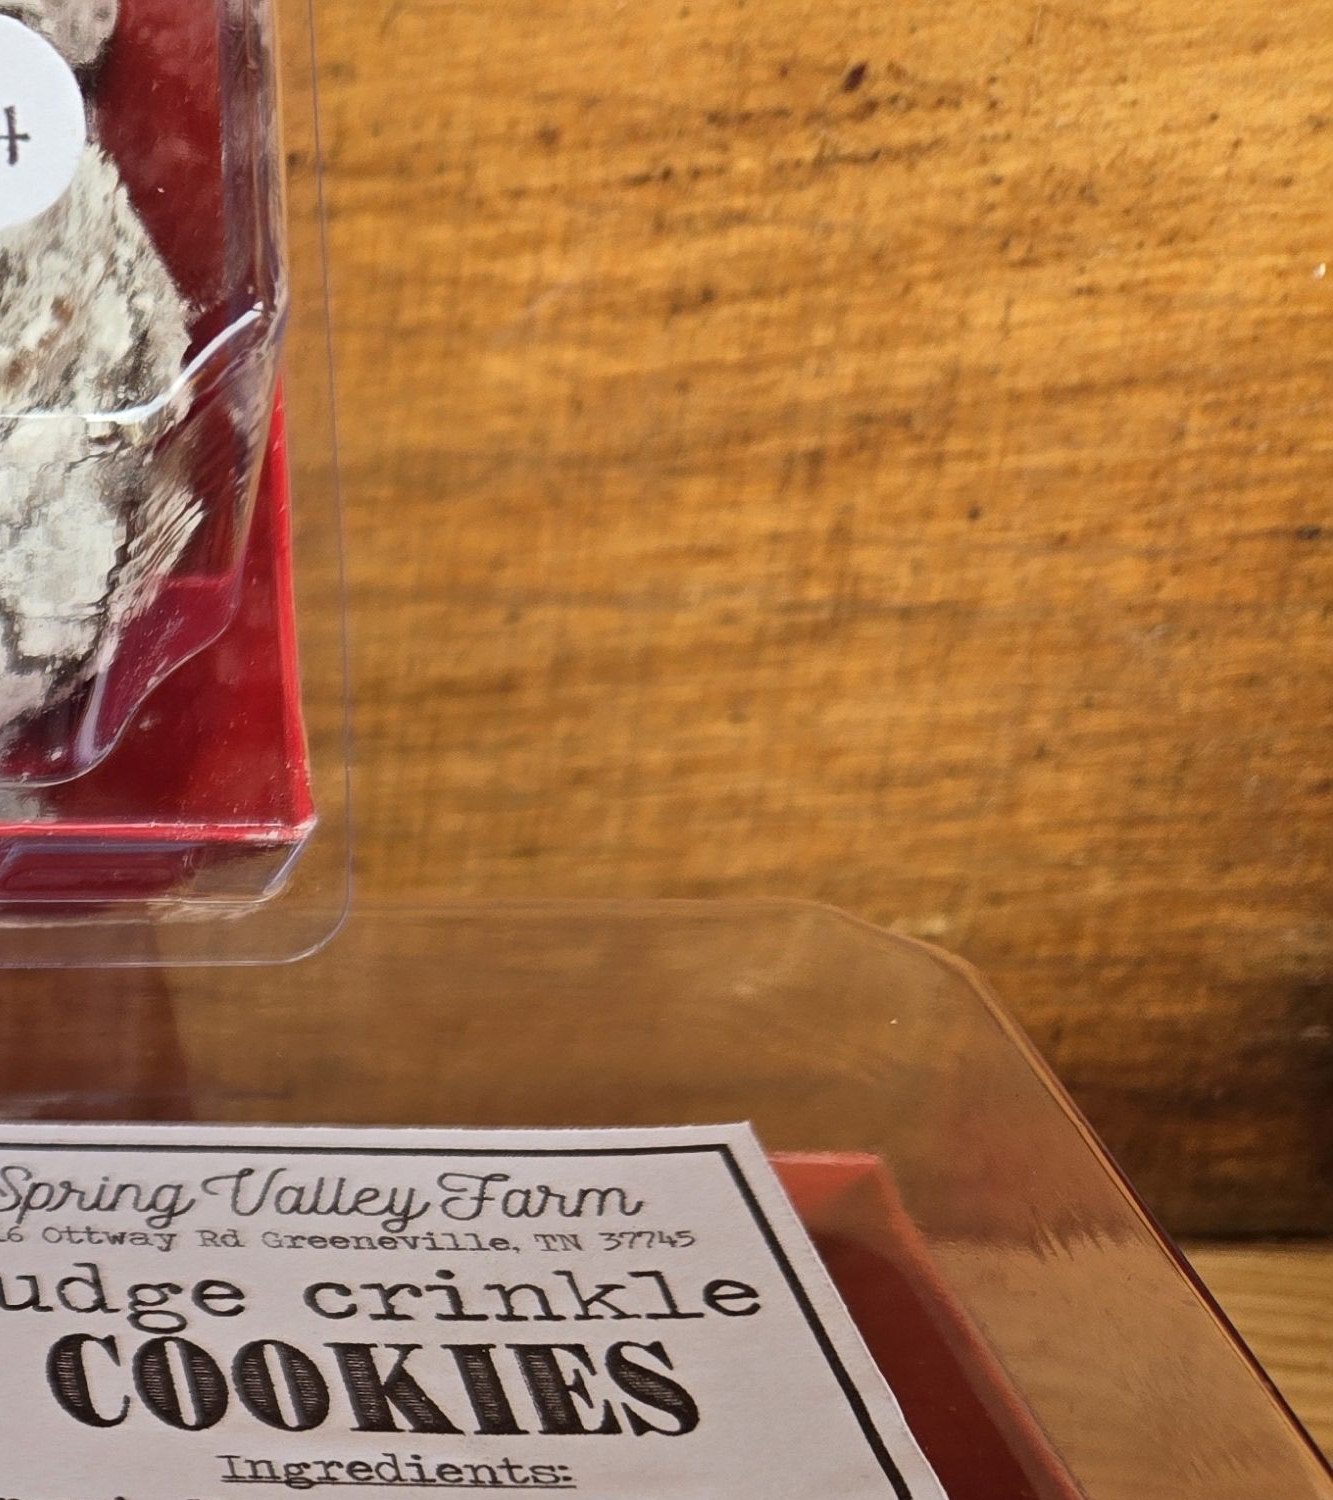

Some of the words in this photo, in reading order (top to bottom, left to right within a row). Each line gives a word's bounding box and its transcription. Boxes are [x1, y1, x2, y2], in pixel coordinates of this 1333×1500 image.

[200, 1167, 432, 1234] Valley
[436, 1172, 646, 1221] Farm
[41, 1226, 178, 1252] Ottway
[196, 1228, 246, 1249] Rd
[260, 1230, 521, 1254] Greeneville,
[532, 1232, 585, 1252] TN
[599, 1230, 696, 1249] 37745
[302, 1268, 762, 1323] crinkle
[44, 1332, 701, 1438] COOKIES
[215, 1453, 577, 1490] Ingredients:
